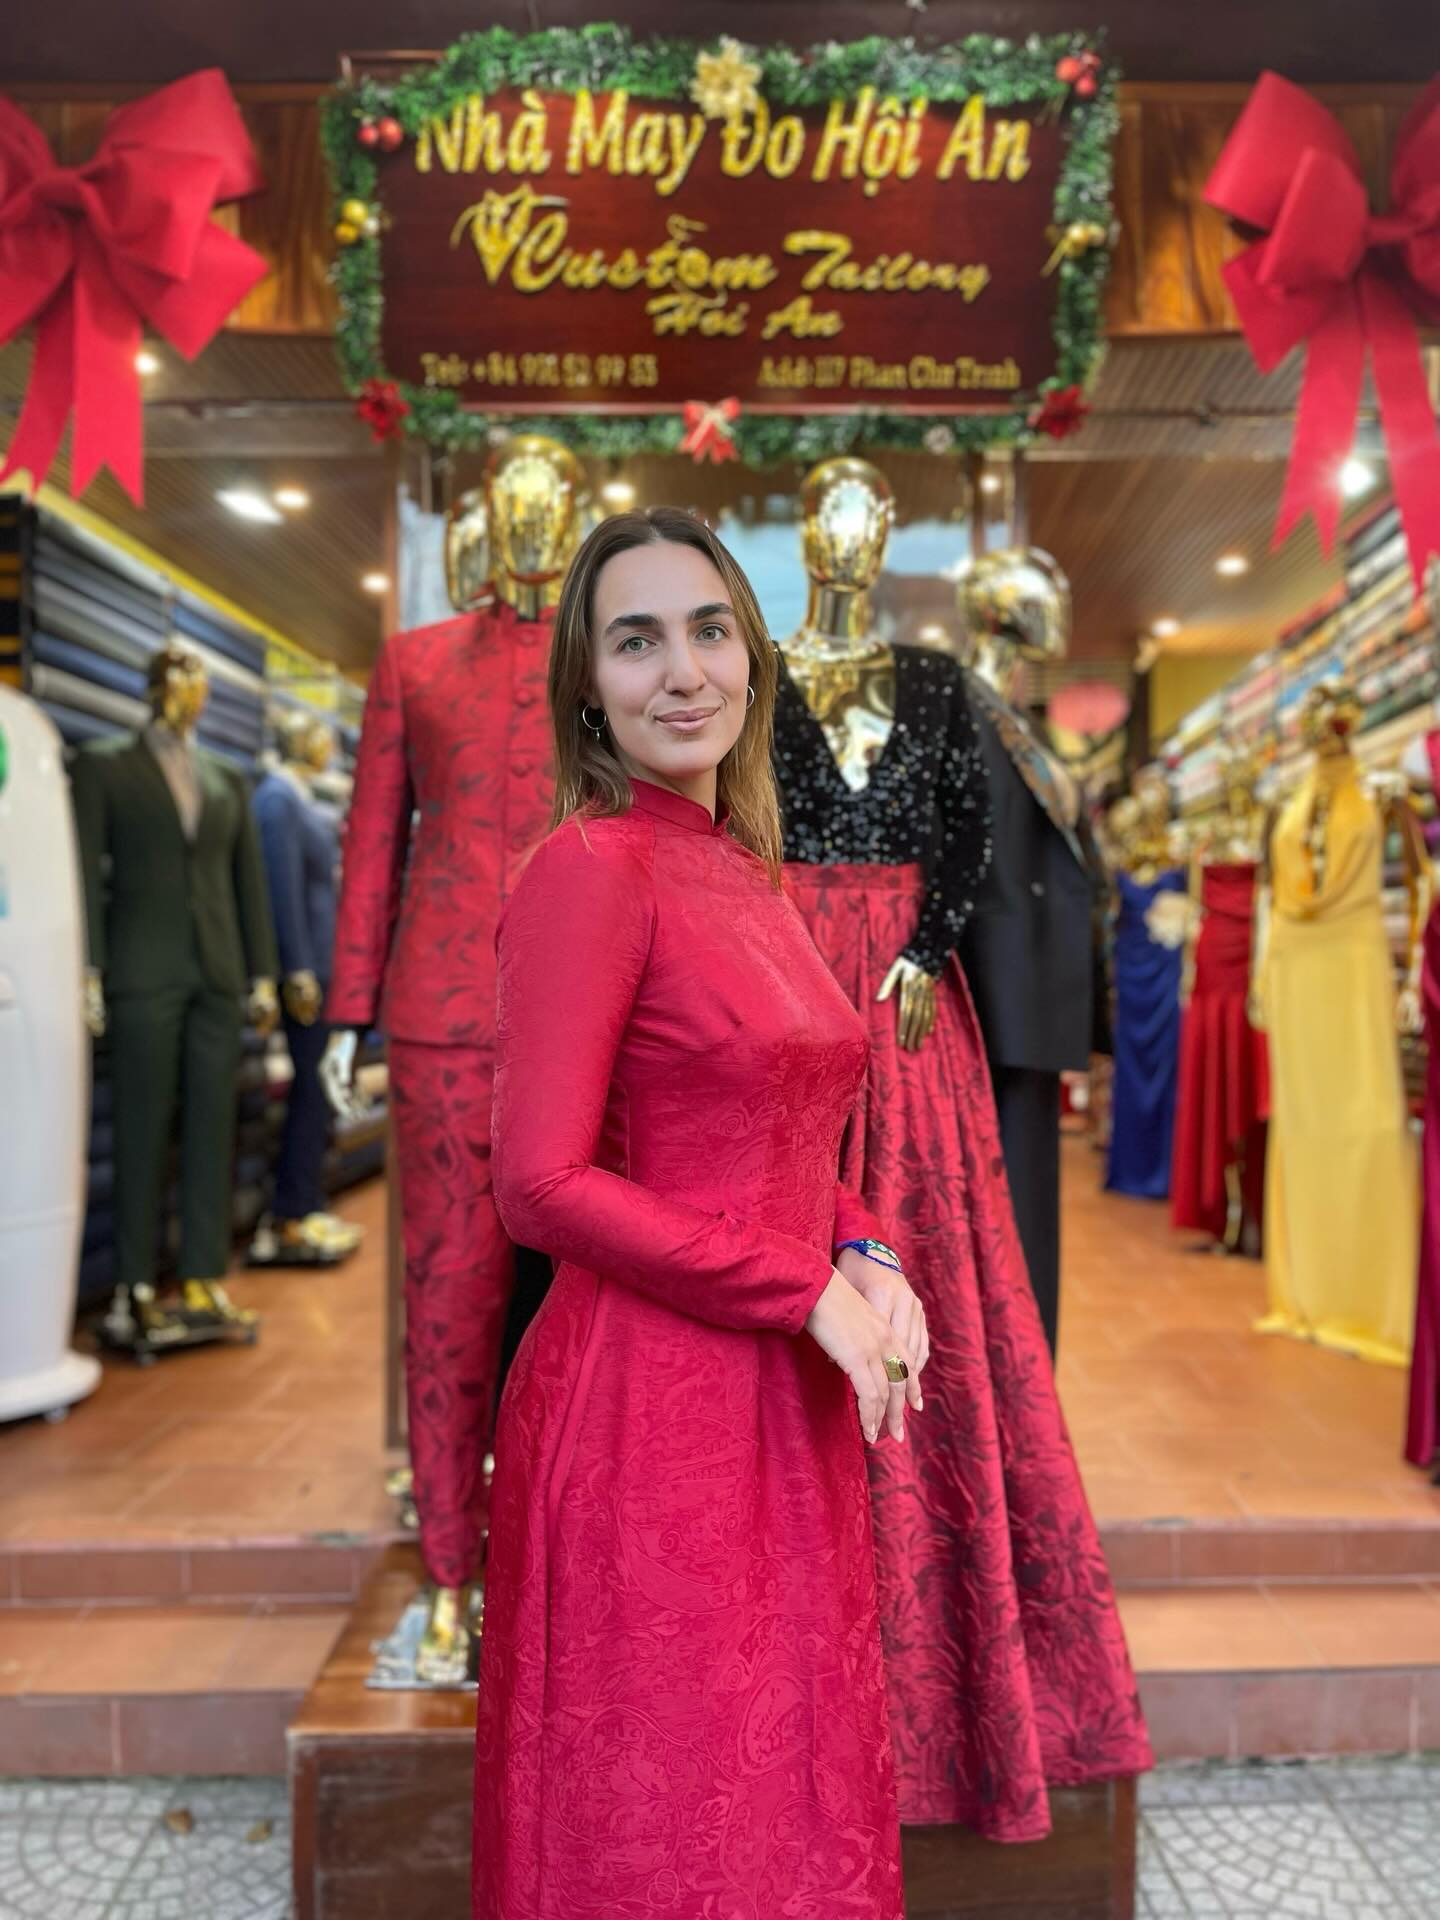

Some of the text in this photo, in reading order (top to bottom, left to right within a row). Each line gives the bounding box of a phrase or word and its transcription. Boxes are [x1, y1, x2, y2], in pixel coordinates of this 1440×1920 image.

[415, 84, 1031, 197] Nhà May Đo Hội An
[510, 209, 778, 293] Custom
[761, 294, 845, 341] An
